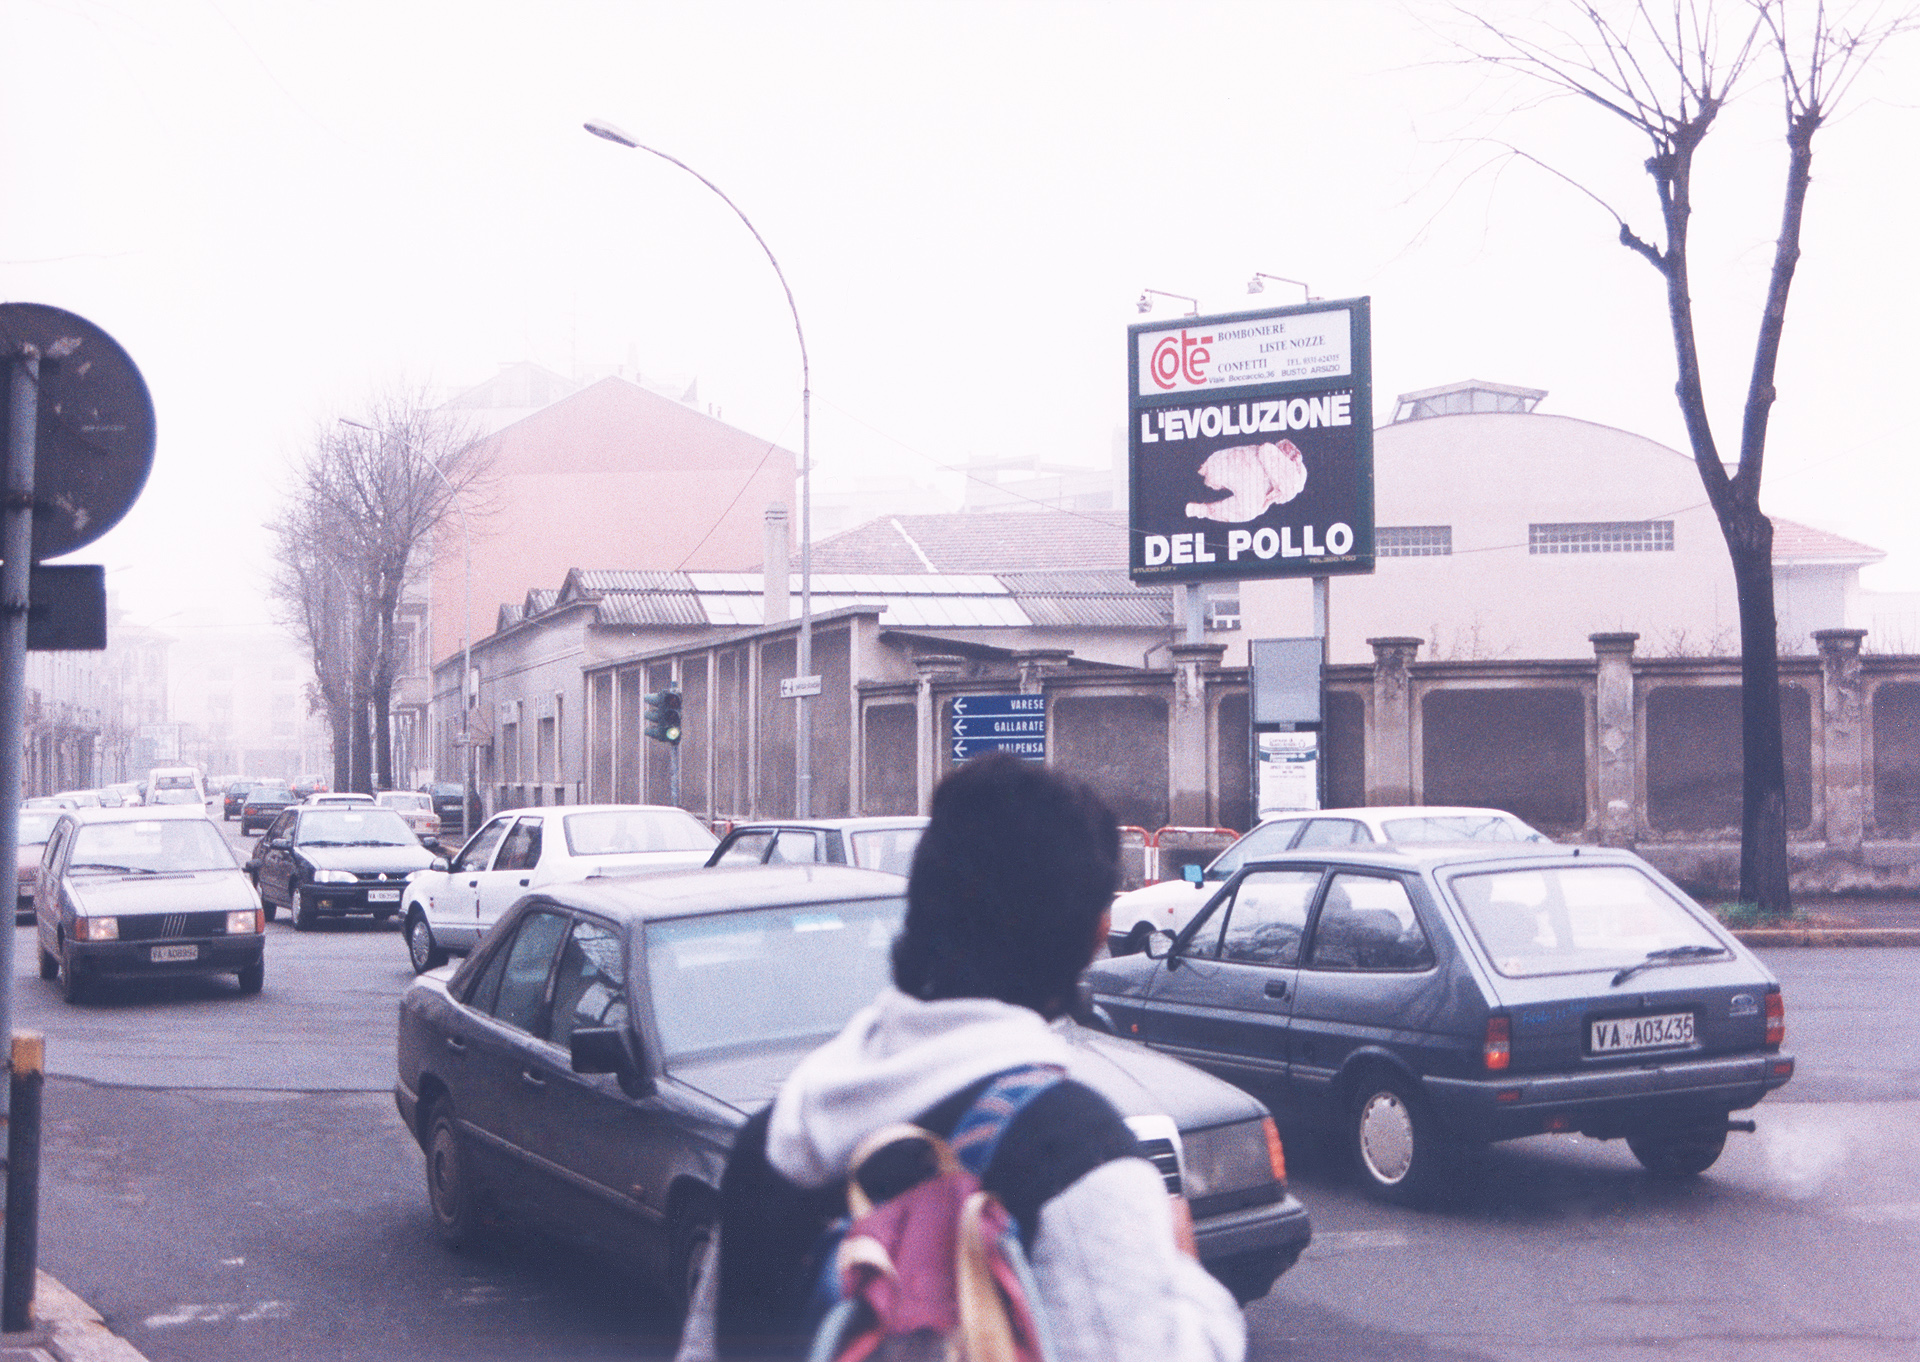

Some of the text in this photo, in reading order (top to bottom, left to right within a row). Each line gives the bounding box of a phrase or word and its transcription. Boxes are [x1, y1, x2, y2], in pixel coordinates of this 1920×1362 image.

[1218, 324, 1286, 342] BOMBONIERE
[1259, 335, 1326, 354] LISTE NOZZE
[1208, 375, 1226, 384] Viale
[1281, 368, 1307, 377] BUSTO
[1310, 364, 1341, 373] ARSIZIO
[1218, 358, 1268, 374] CONFETTI
[1141, 394, 1352, 443] L'EVOLUZIONE
[1145, 522, 1354, 566] DEL POLLO
[1010, 699, 1044, 710] VARESE
[994, 721, 1044, 732] GALLARATE
[1596, 1016, 1694, 1047] VA A03435
